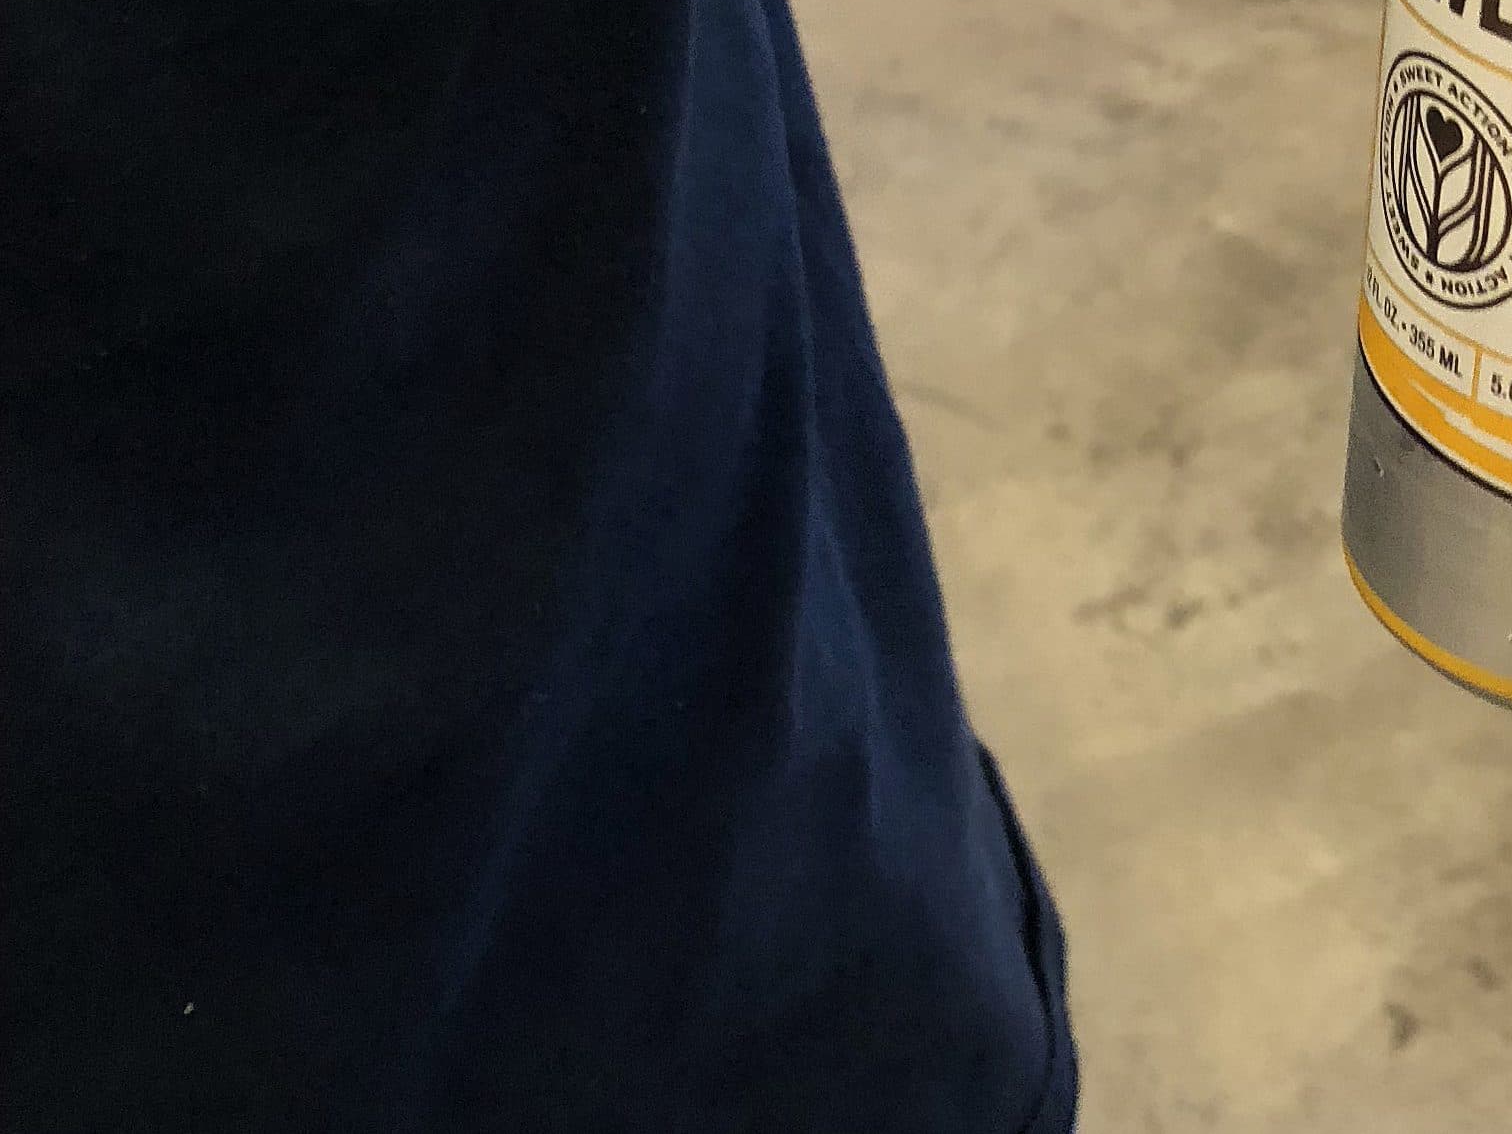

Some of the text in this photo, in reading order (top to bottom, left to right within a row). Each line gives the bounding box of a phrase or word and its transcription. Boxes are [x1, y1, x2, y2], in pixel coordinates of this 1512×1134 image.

[1399, 64, 1512, 157] SWEET ACTION
[1440, 266, 1509, 298] ACTION
[1408, 322, 1436, 361] 355
[1438, 344, 1463, 378] ML
